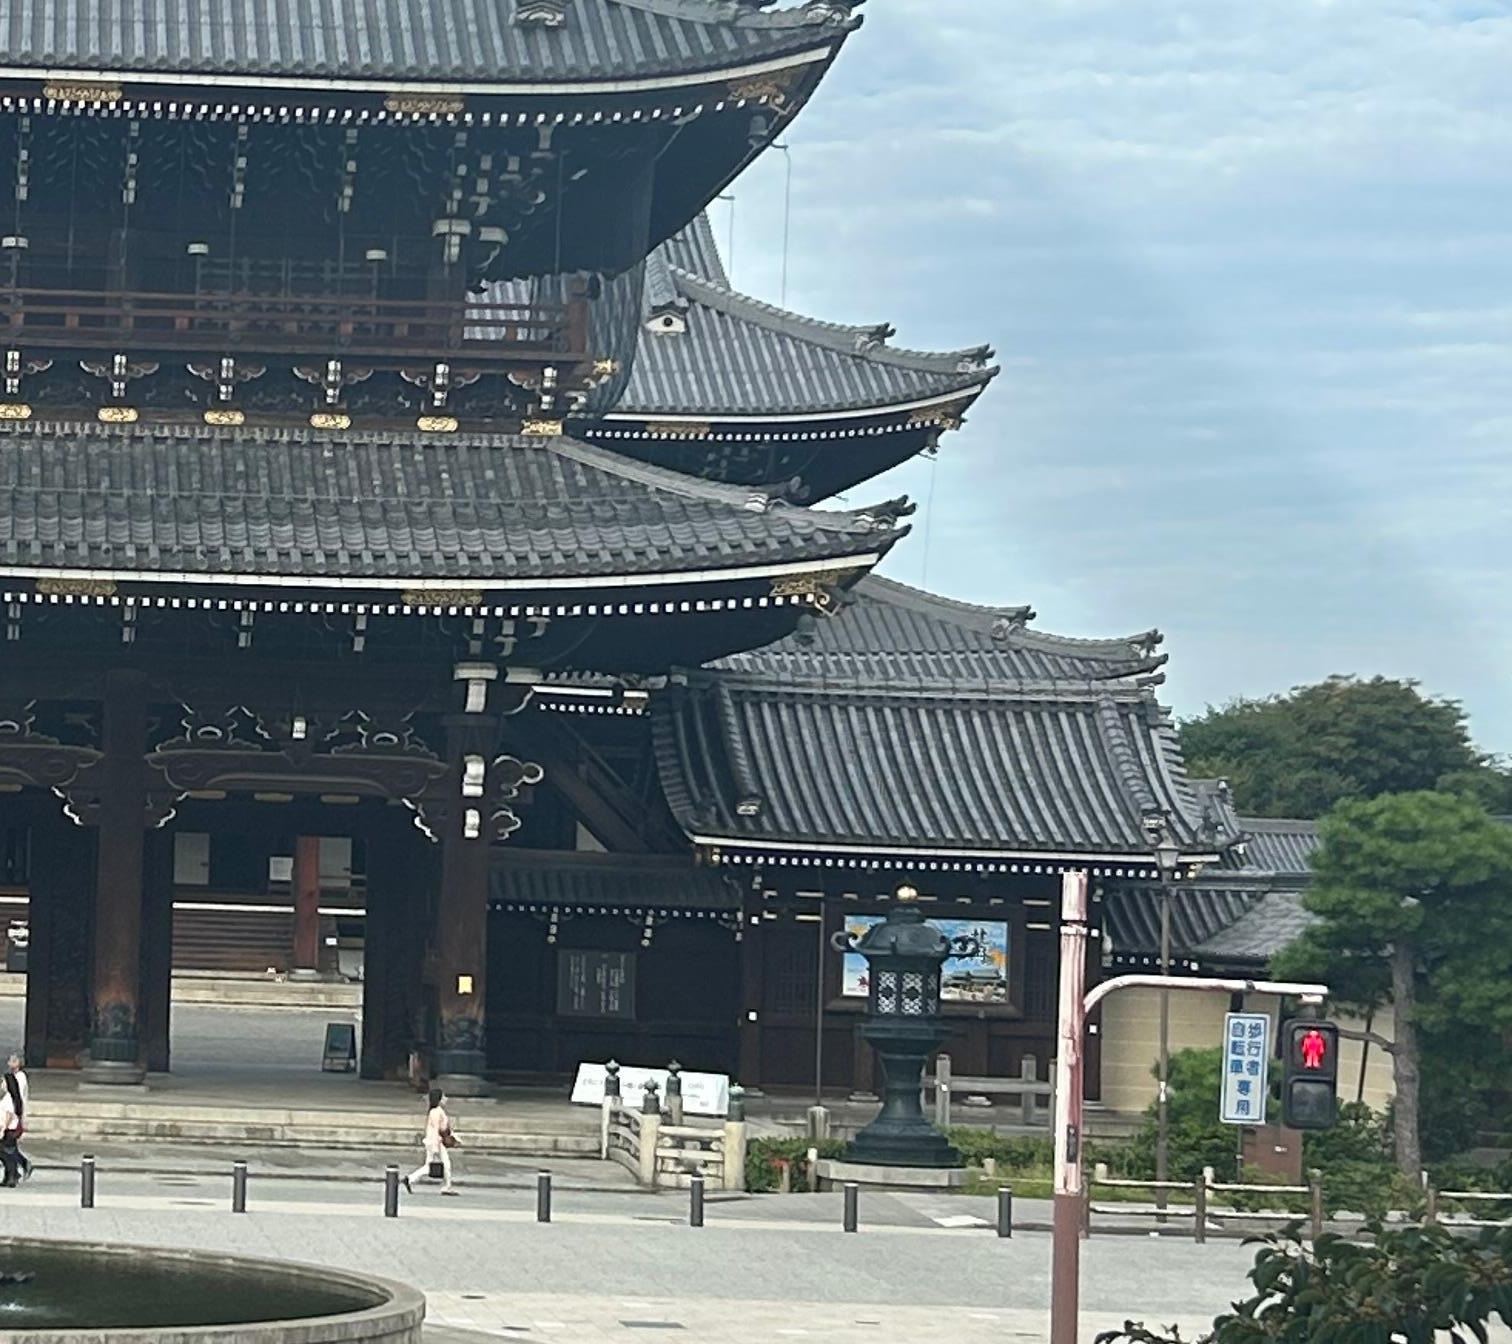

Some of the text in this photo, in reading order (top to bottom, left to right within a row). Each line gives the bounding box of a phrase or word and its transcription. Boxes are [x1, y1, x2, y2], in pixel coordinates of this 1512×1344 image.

[1231, 1021, 1245, 1073] 自転車
[1246, 1023, 1262, 1075] 歩行者
[1236, 1081, 1251, 1115] 専用
